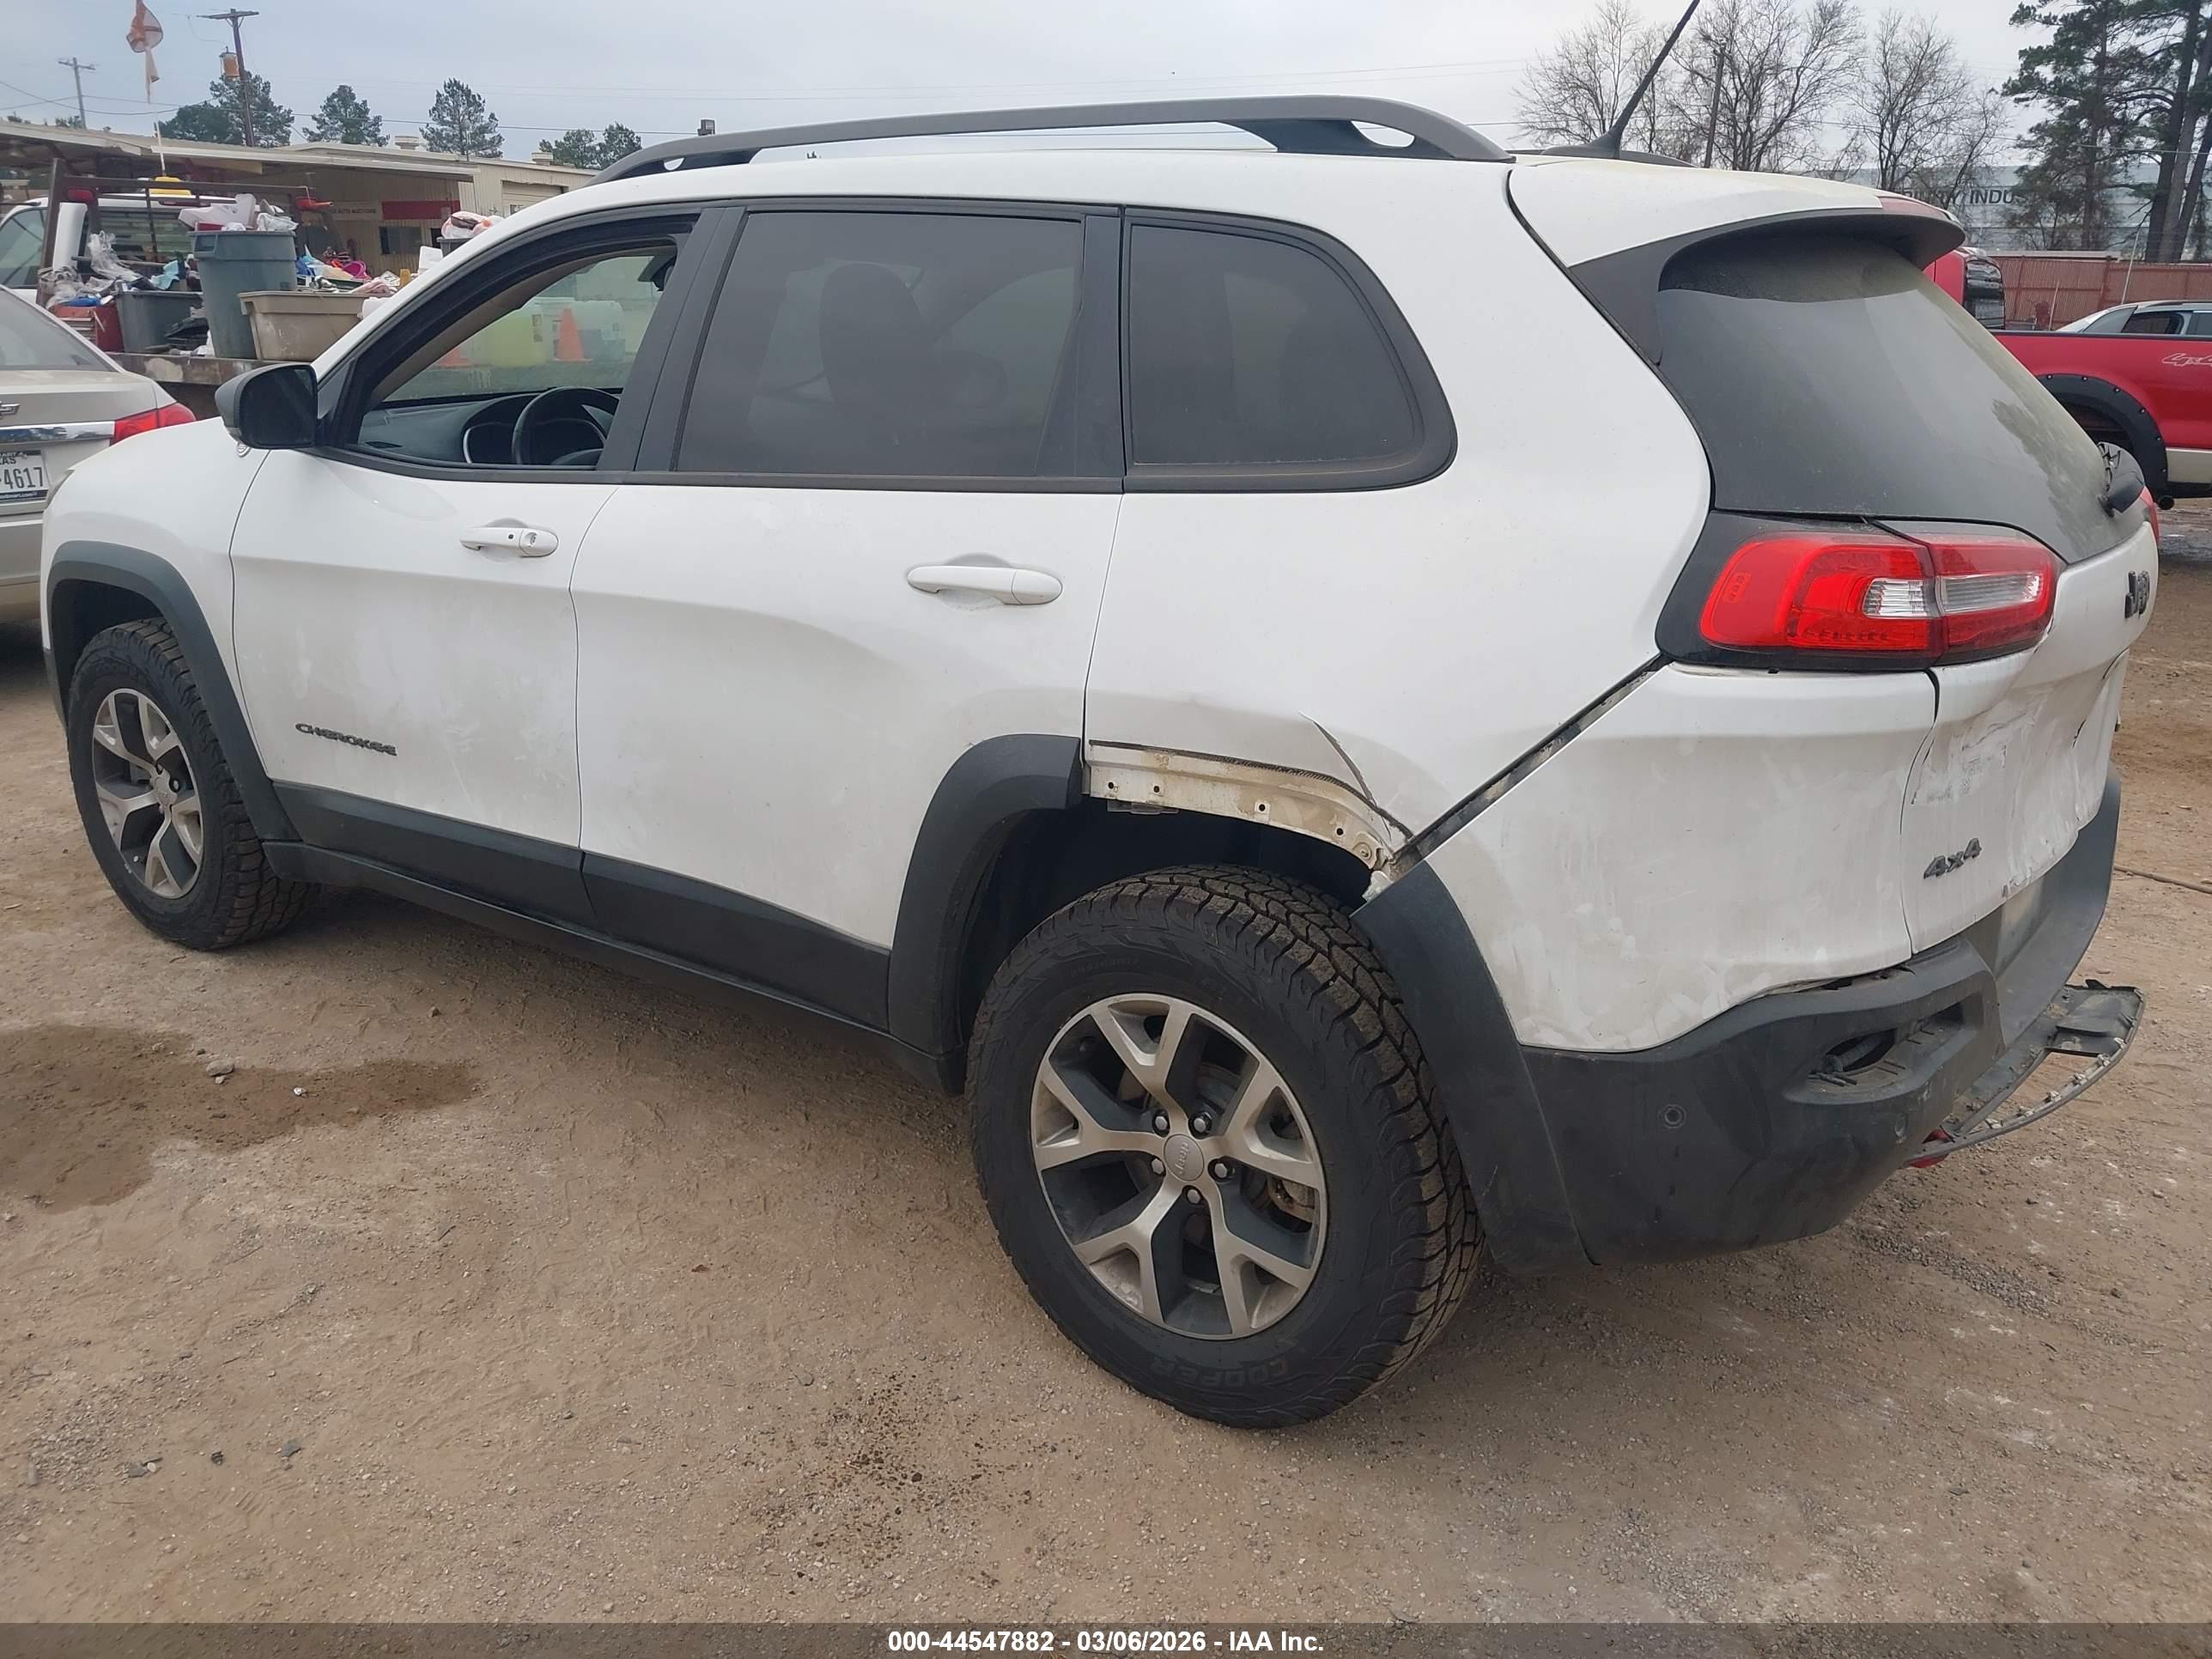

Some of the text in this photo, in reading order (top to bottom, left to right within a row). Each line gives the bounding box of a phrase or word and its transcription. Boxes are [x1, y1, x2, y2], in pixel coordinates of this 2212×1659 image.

[4, 467, 44, 489] 4617
[295, 723, 398, 756] CHEROKEE
[1923, 837, 1982, 879] 4x4
[1150, 1355, 1289, 1389] COOPER
